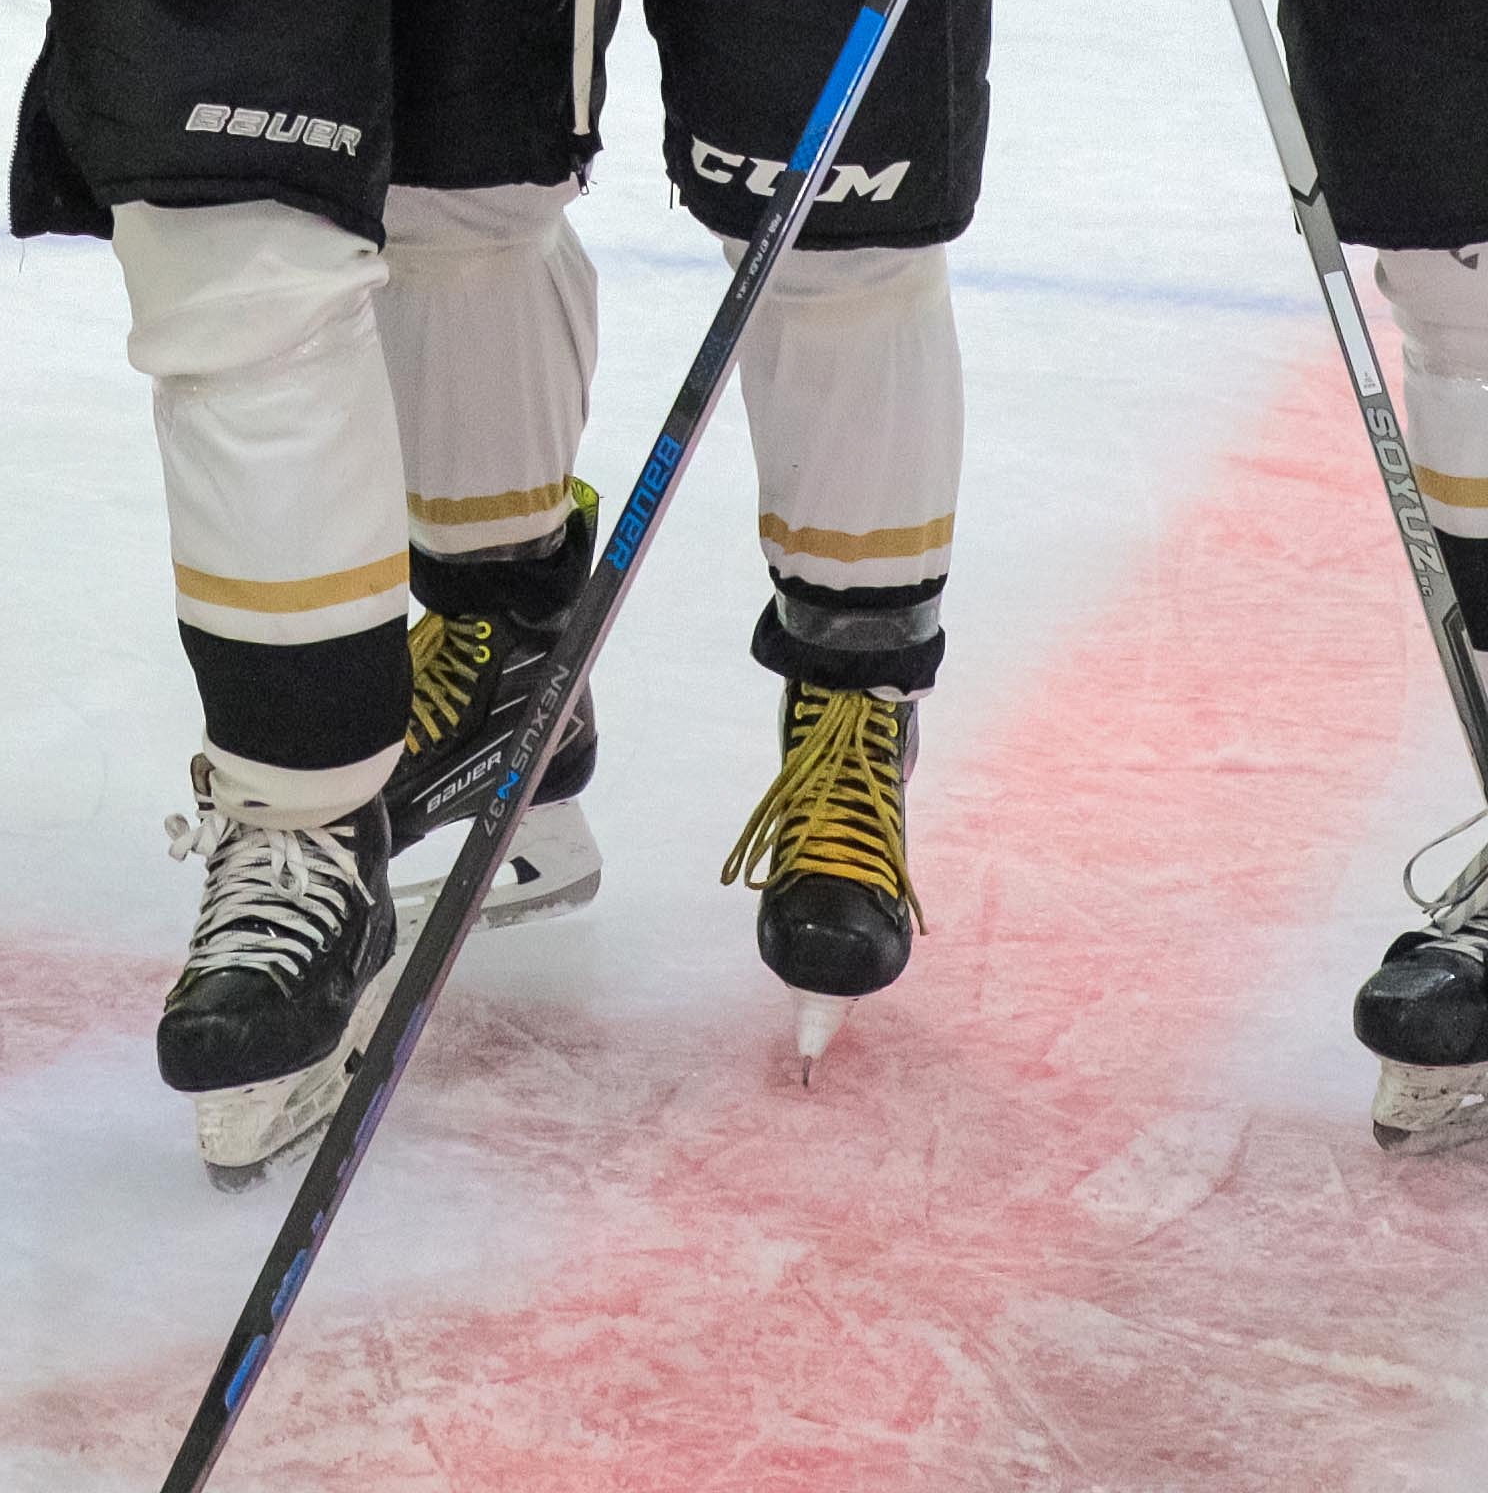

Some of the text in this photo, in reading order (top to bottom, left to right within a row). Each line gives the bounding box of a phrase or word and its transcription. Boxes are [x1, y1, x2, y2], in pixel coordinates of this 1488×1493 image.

[185, 103, 363, 157] BAUER
[606, 434, 682, 573] BAUER
[1363, 407, 1446, 580] SOYUZ
[508, 664, 570, 775] NEXUS
[425, 750, 503, 815] BAUER
